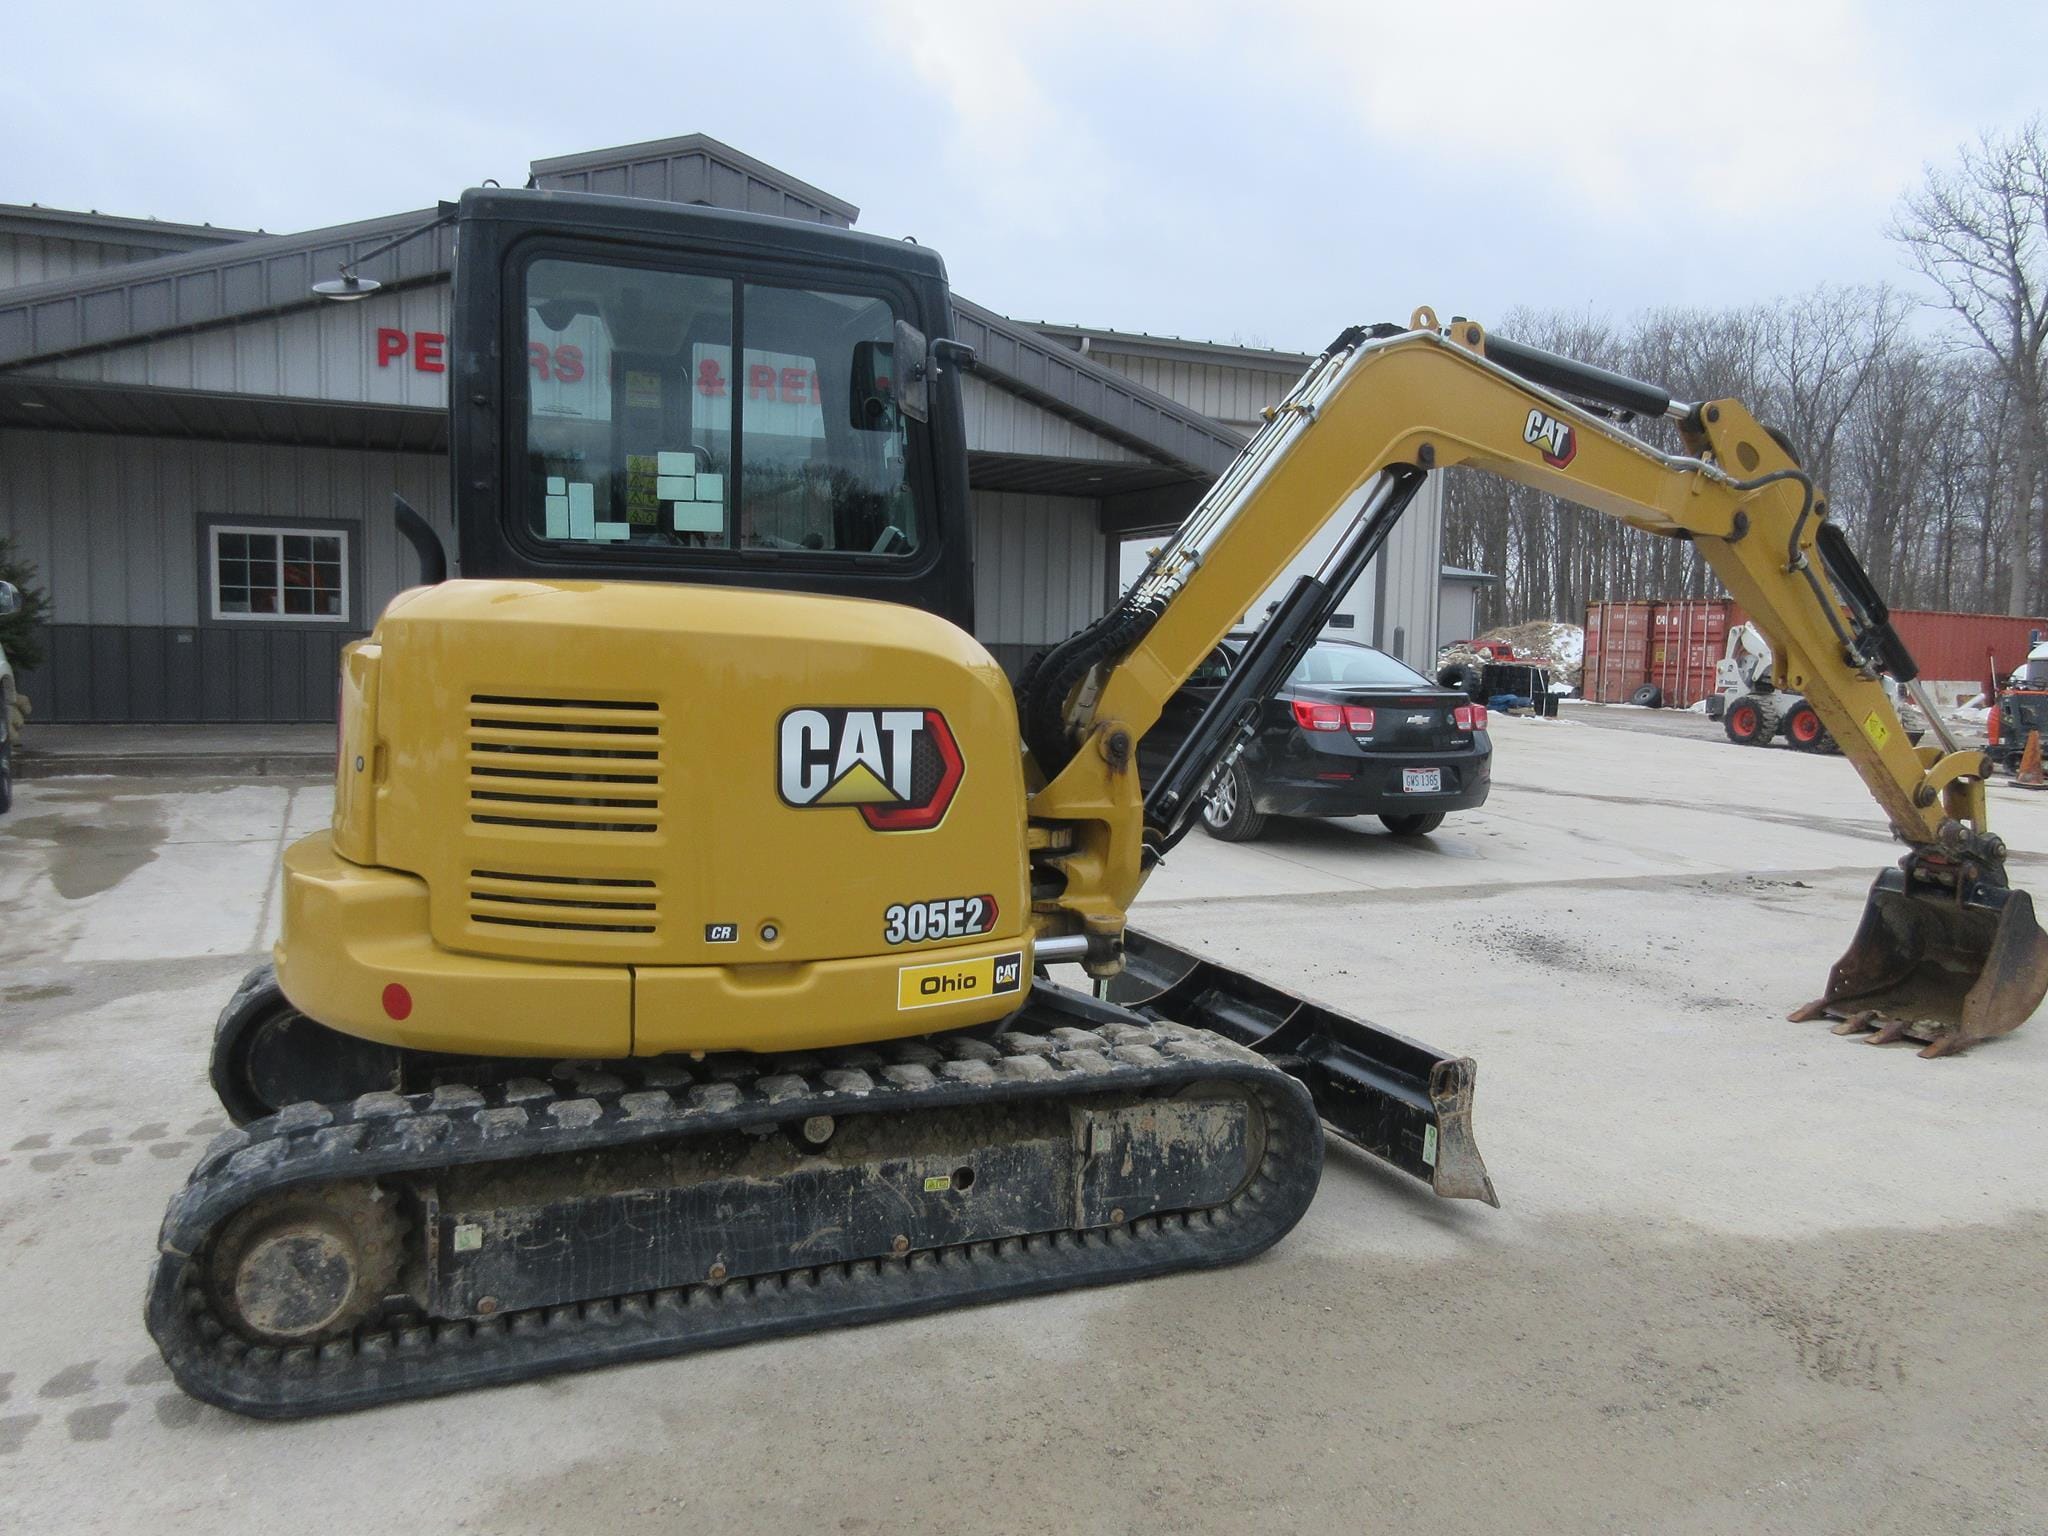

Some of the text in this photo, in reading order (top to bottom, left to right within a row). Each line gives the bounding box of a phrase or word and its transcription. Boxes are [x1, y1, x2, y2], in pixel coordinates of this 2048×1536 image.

[378, 328, 585, 383] PERS
[697, 358, 726, 397] &
[1524, 410, 1569, 457] CAT
[781, 710, 924, 805] CAT
[1421, 774, 1438, 787] 1365
[711, 926, 732, 939] CR
[886, 898, 984, 943] 305E2
[920, 963, 1019, 995] Ohio CAT
